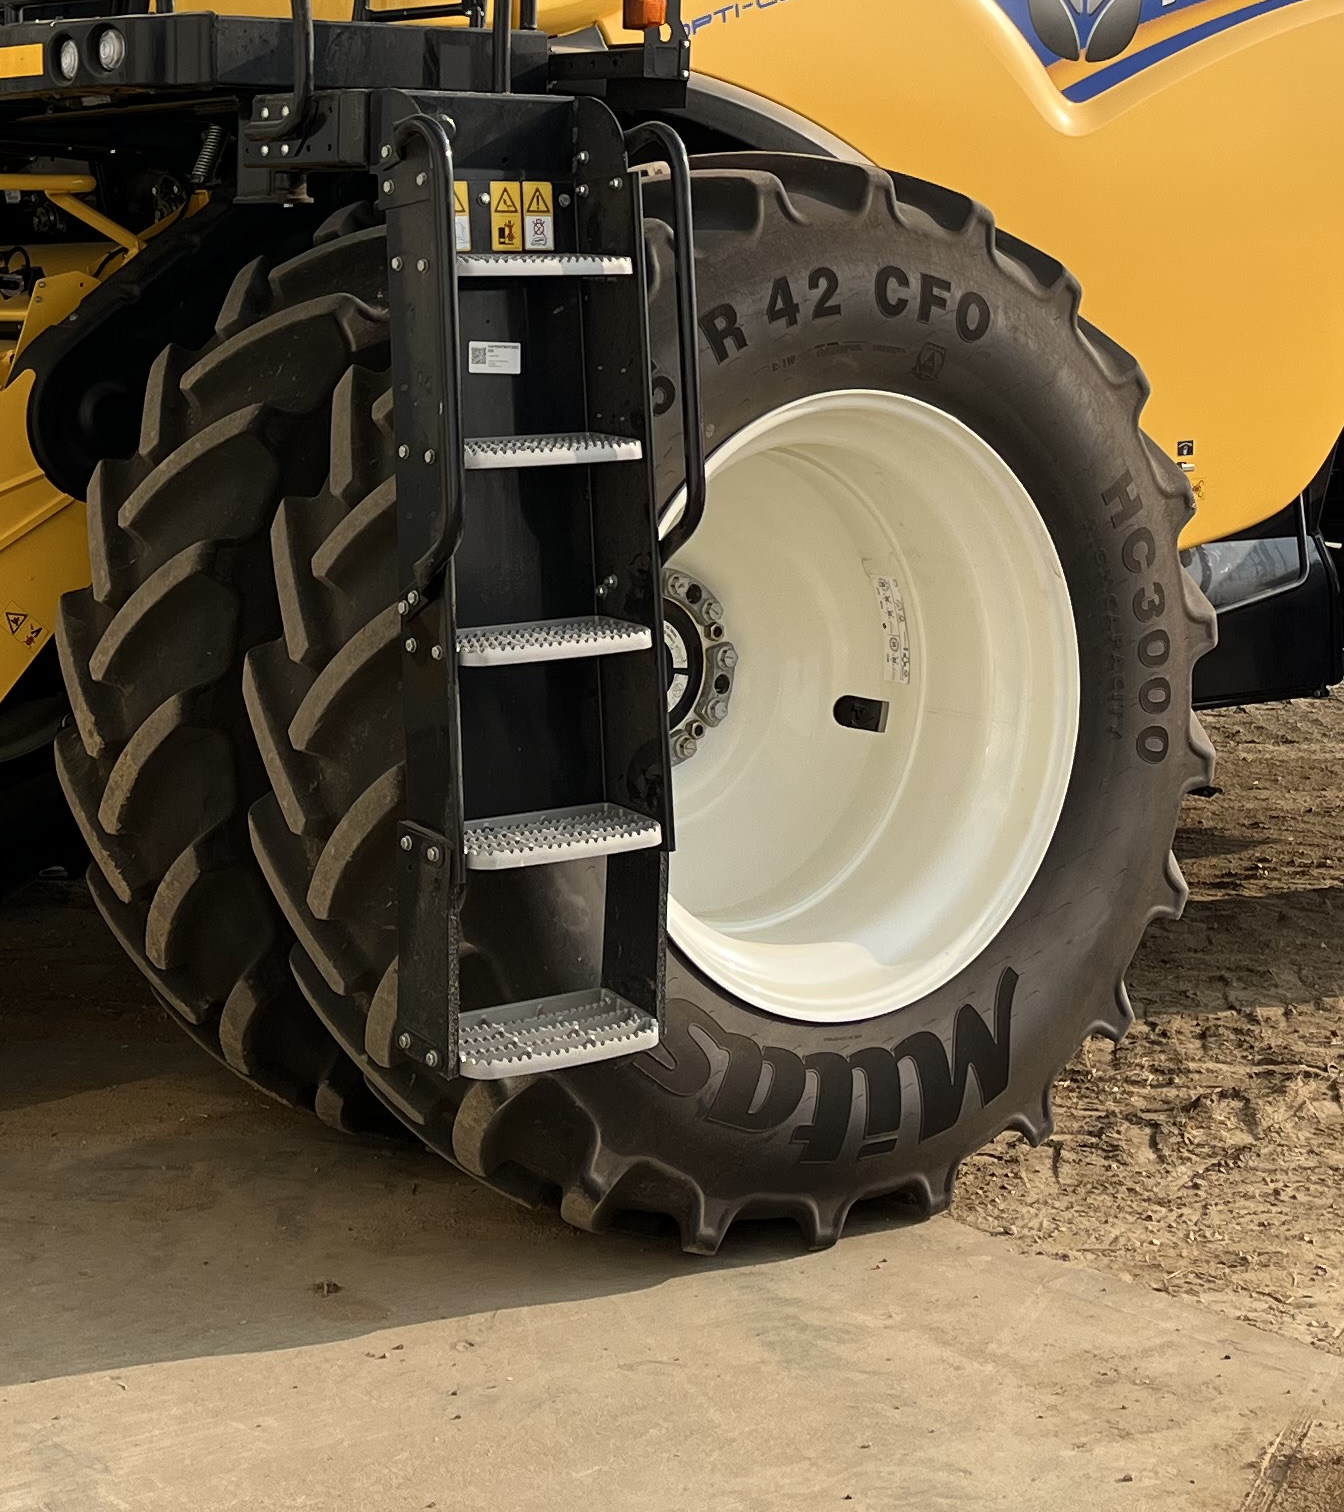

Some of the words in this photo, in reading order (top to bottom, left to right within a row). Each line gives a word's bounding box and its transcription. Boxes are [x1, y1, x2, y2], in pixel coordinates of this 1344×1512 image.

[699, 303, 749, 365] R
[766, 266, 842, 330] 42
[874, 265, 991, 344] CFO
[633, 966, 1020, 1166] Mitas
